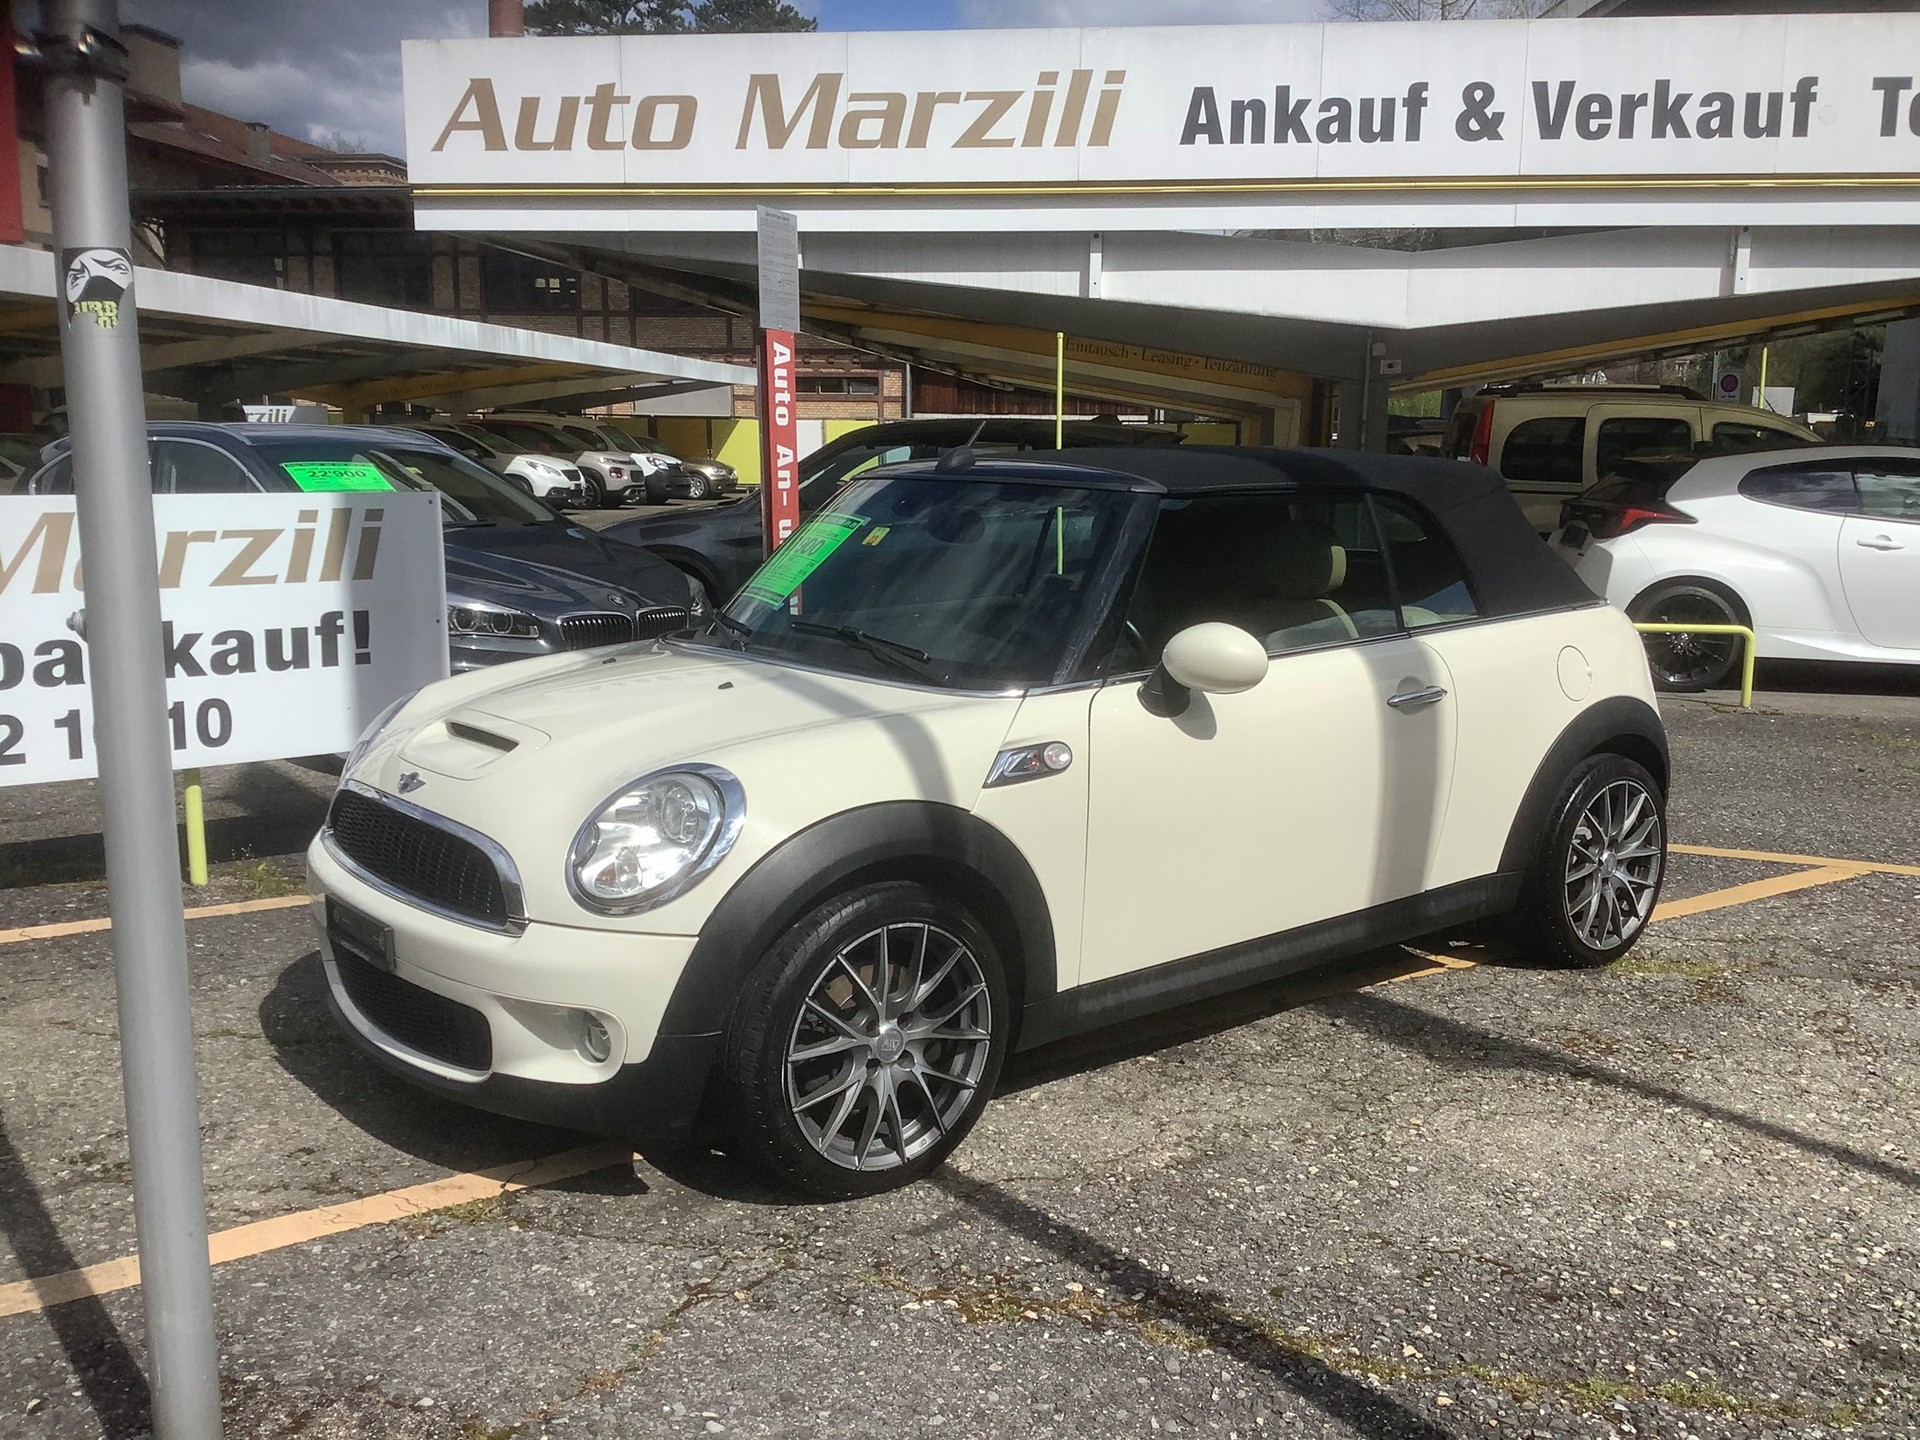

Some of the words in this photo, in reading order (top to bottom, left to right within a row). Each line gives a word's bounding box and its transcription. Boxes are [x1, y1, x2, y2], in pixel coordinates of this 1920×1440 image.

[431, 77, 698, 152] Auto
[735, 68, 1127, 150] Marzili
[1179, 81, 1430, 146] Ankauf
[1455, 81, 1506, 143] &
[1531, 76, 1819, 141] Verkauf
[773, 341, 791, 427] Auto
[1141, 347, 1193, 370] Leasing
[776, 443, 794, 507] An-
[0, 508, 384, 595] Mrzili
